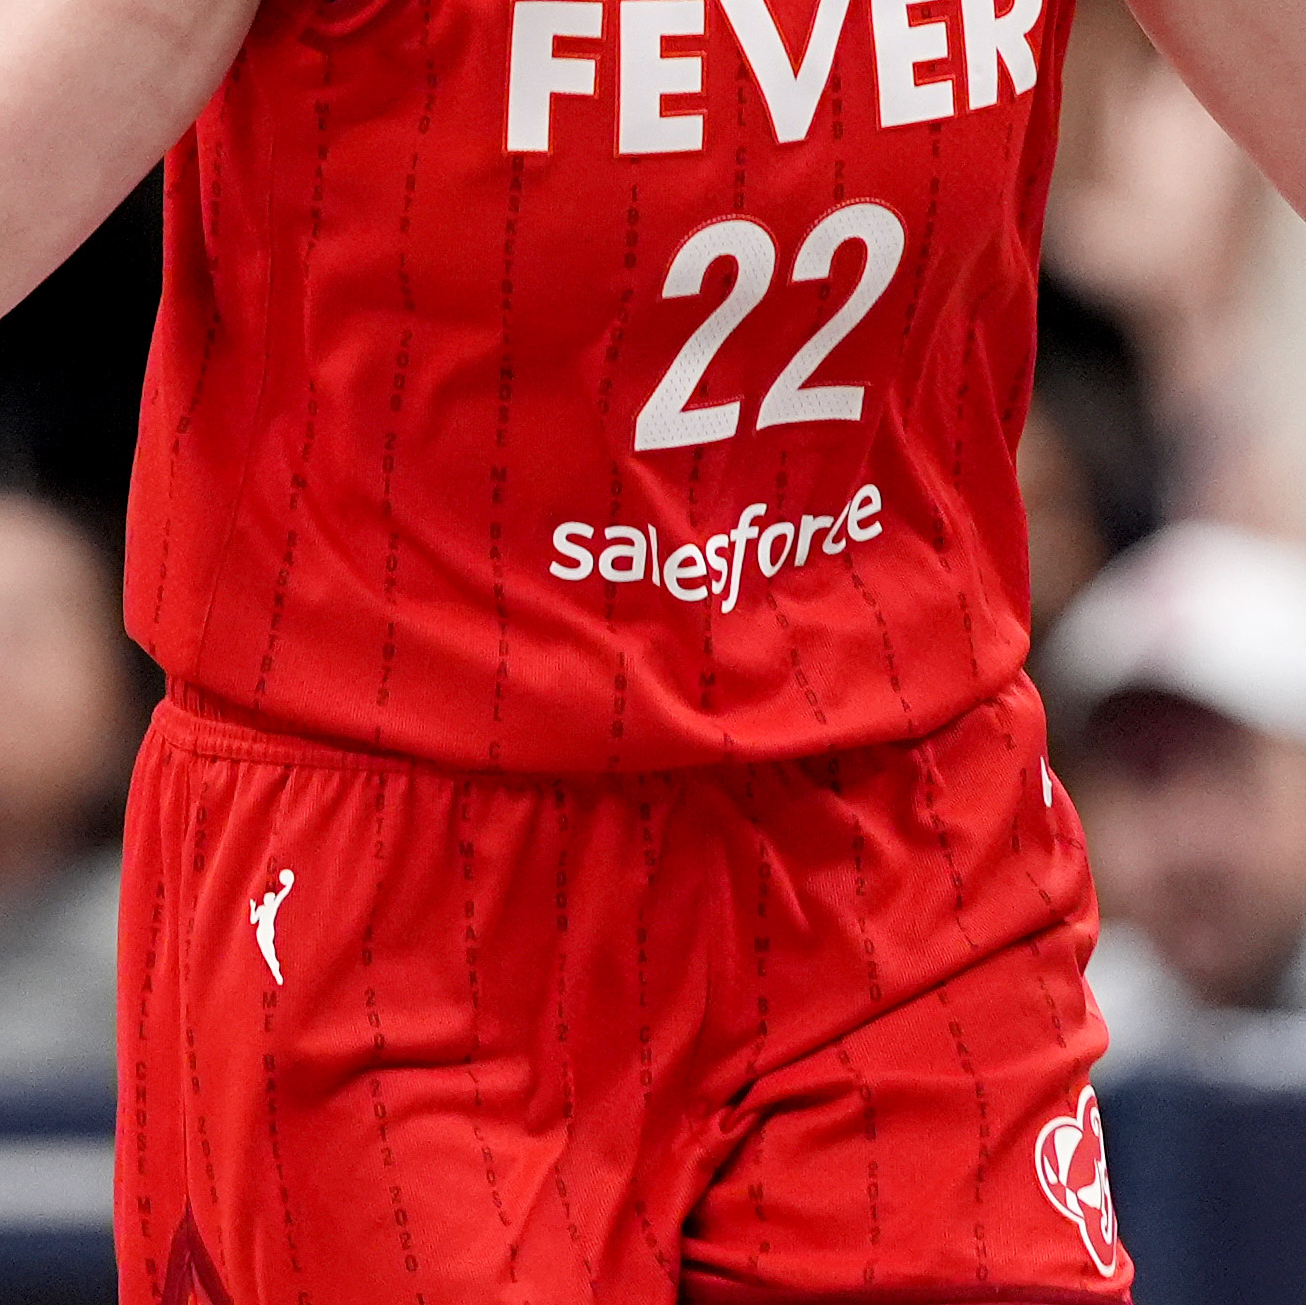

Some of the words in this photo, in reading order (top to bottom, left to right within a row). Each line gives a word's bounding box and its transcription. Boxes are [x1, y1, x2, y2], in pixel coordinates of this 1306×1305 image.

[635, 204, 904, 450] 22
[550, 485, 882, 613] salesforce
[262, 991, 278, 1034] ME
[390, 1185, 419, 1274] 2020
